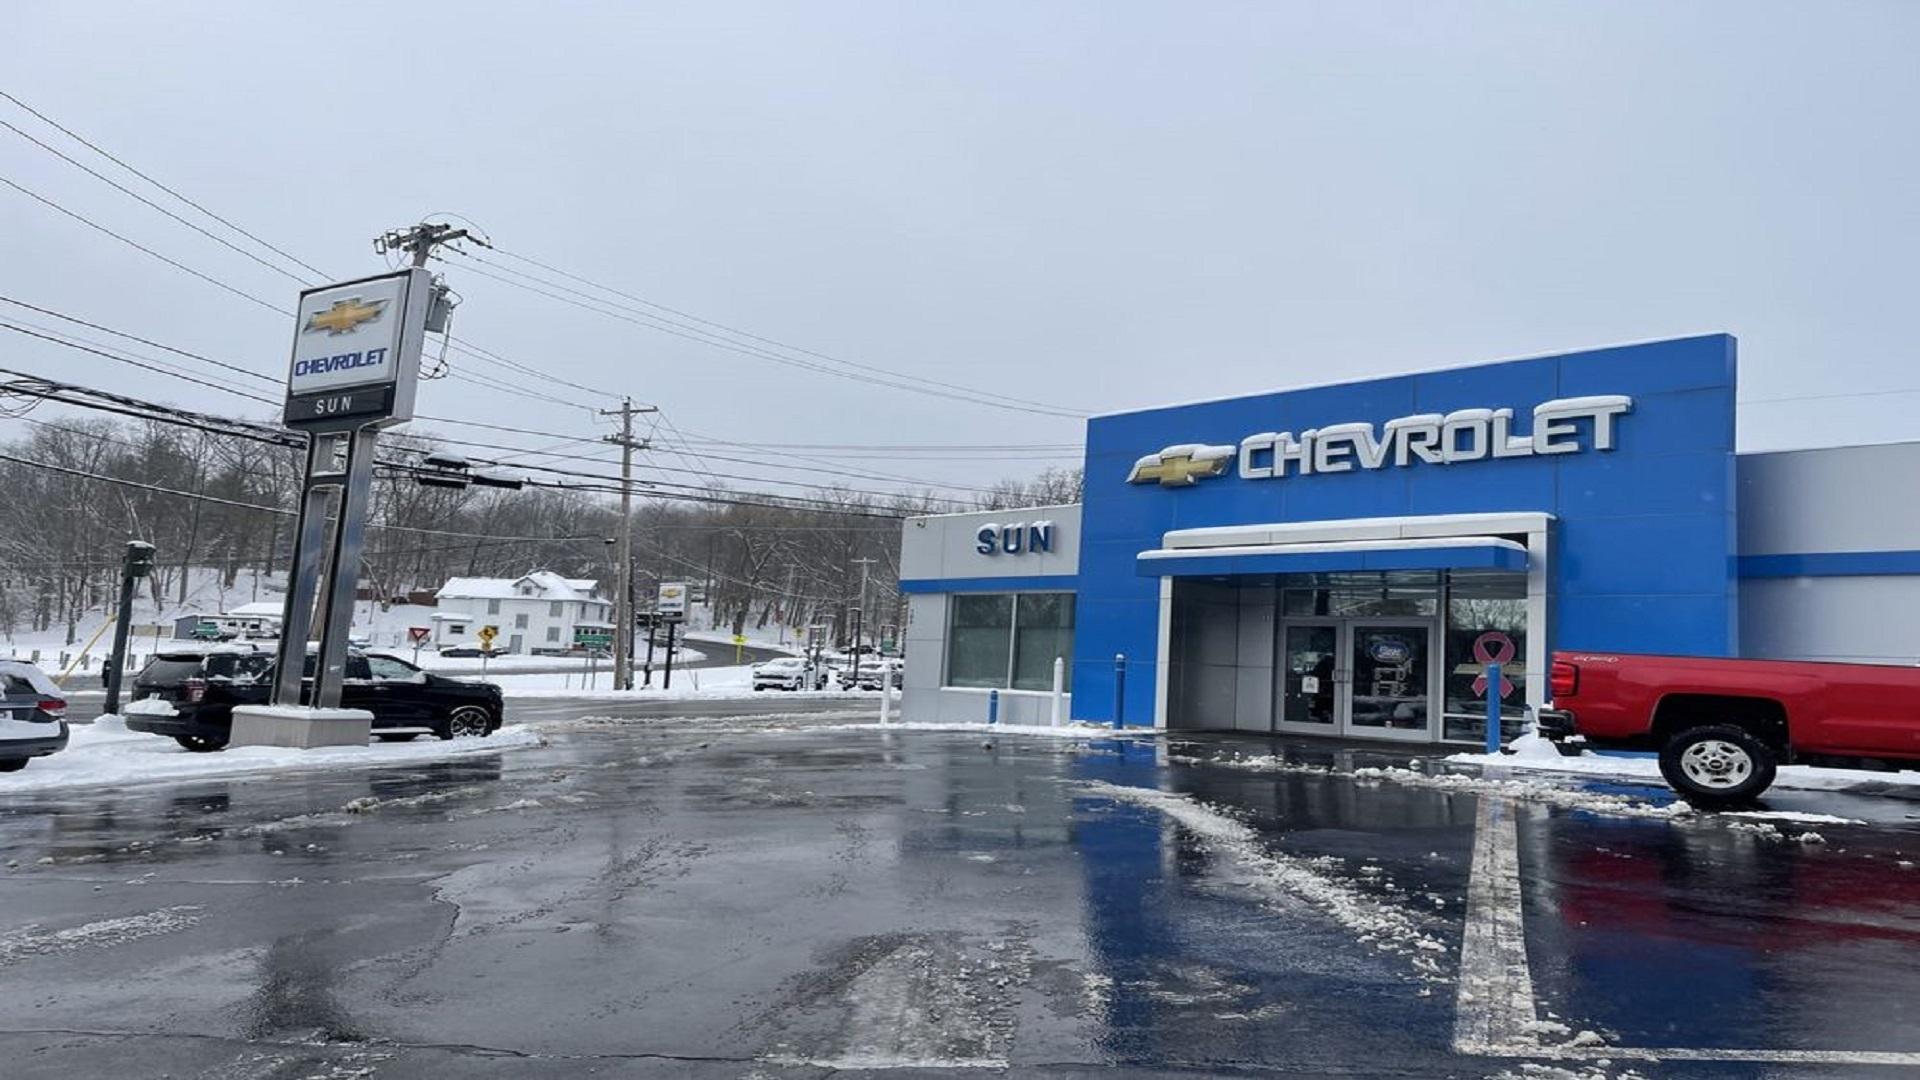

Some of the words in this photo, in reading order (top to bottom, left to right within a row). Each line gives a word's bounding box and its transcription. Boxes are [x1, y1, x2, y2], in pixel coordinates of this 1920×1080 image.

[295, 348, 388, 376] CHEVROLET
[315, 396, 353, 414] SUN
[1240, 397, 1632, 479] CHEVROLET
[976, 522, 1054, 555] SUN
